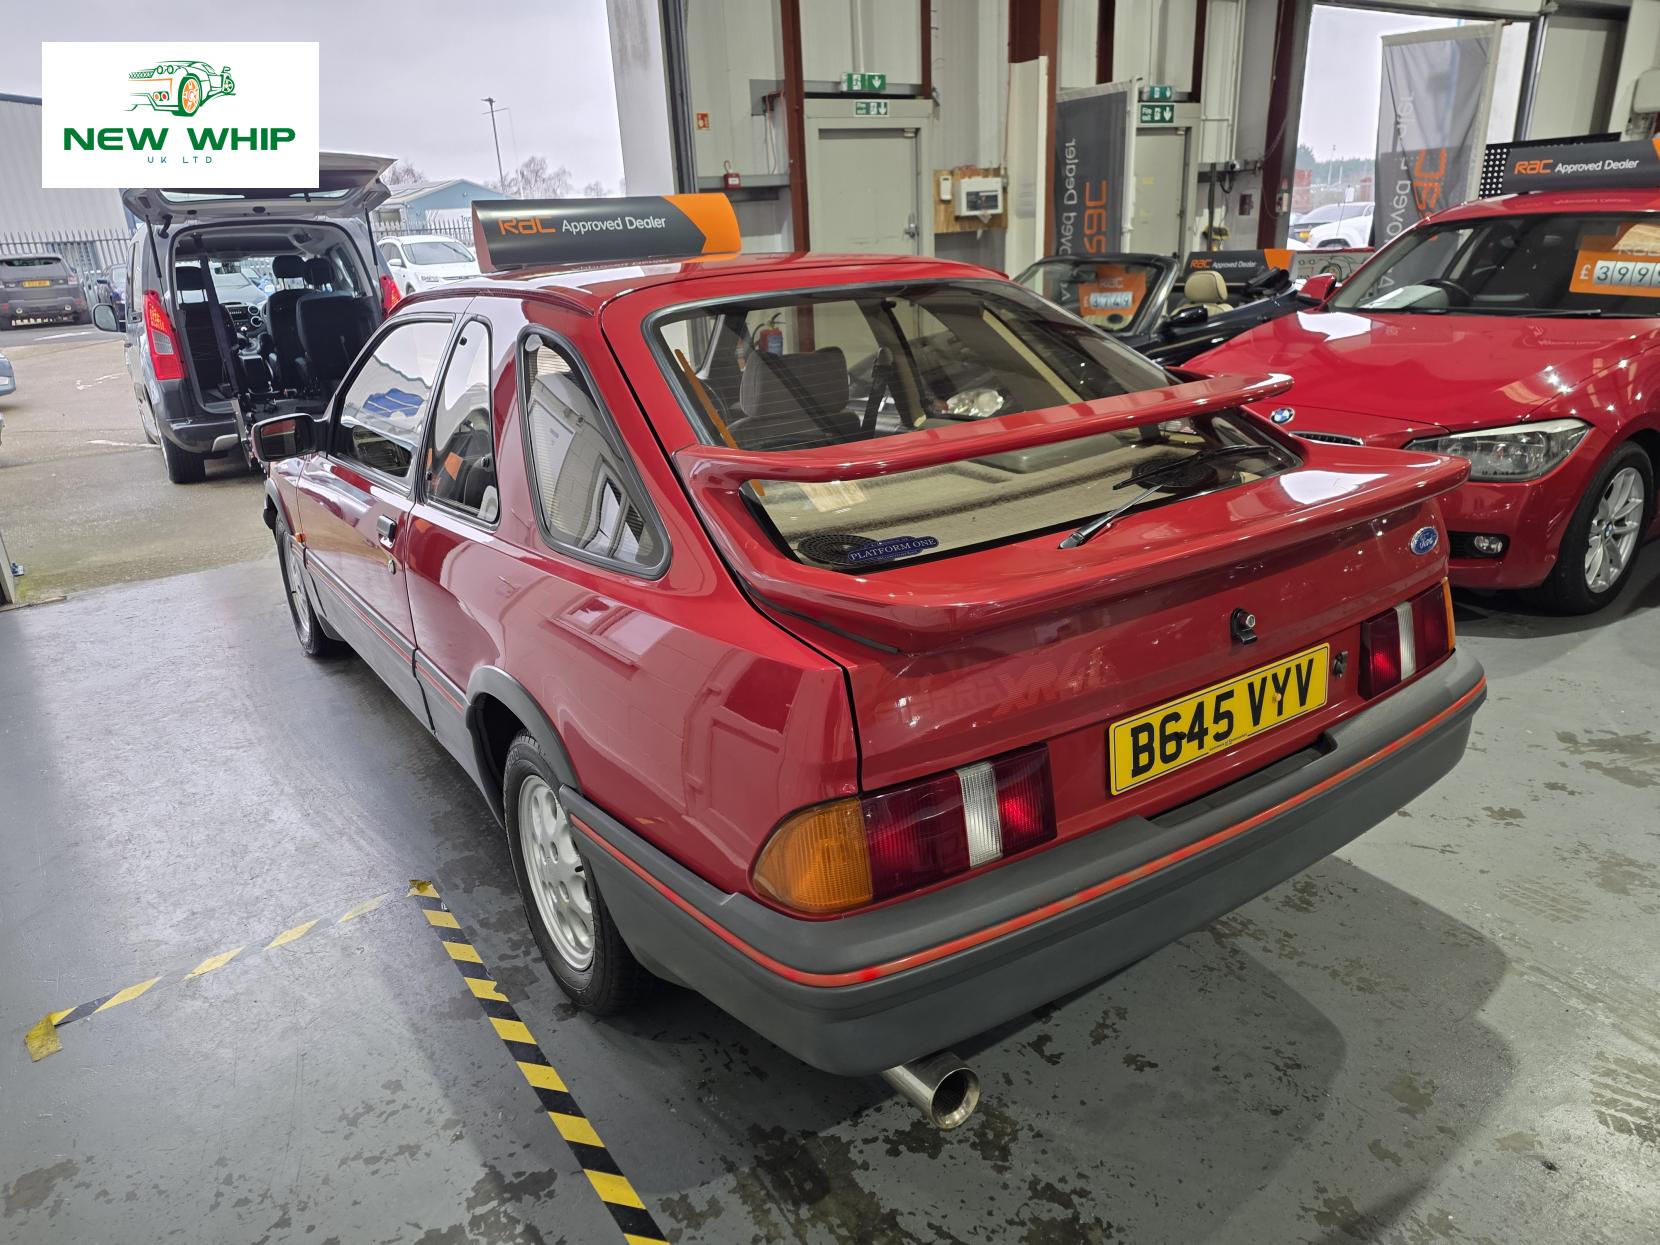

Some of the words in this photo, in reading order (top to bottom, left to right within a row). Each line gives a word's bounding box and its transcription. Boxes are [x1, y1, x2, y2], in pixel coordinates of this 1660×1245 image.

[1554, 160, 1602, 174] Approved
[1604, 159, 1640, 170] Dealer
[562, 217, 623, 235] Approved
[625, 216, 667, 230] Dealer
[1580, 264, 1592, 280] £
[1597, 265, 1660, 283] 399
[850, 542, 911, 560] PLATFORM
[912, 538, 937, 548] ONE
[1130, 689, 1235, 779] B645
[1247, 658, 1314, 727] VYV
